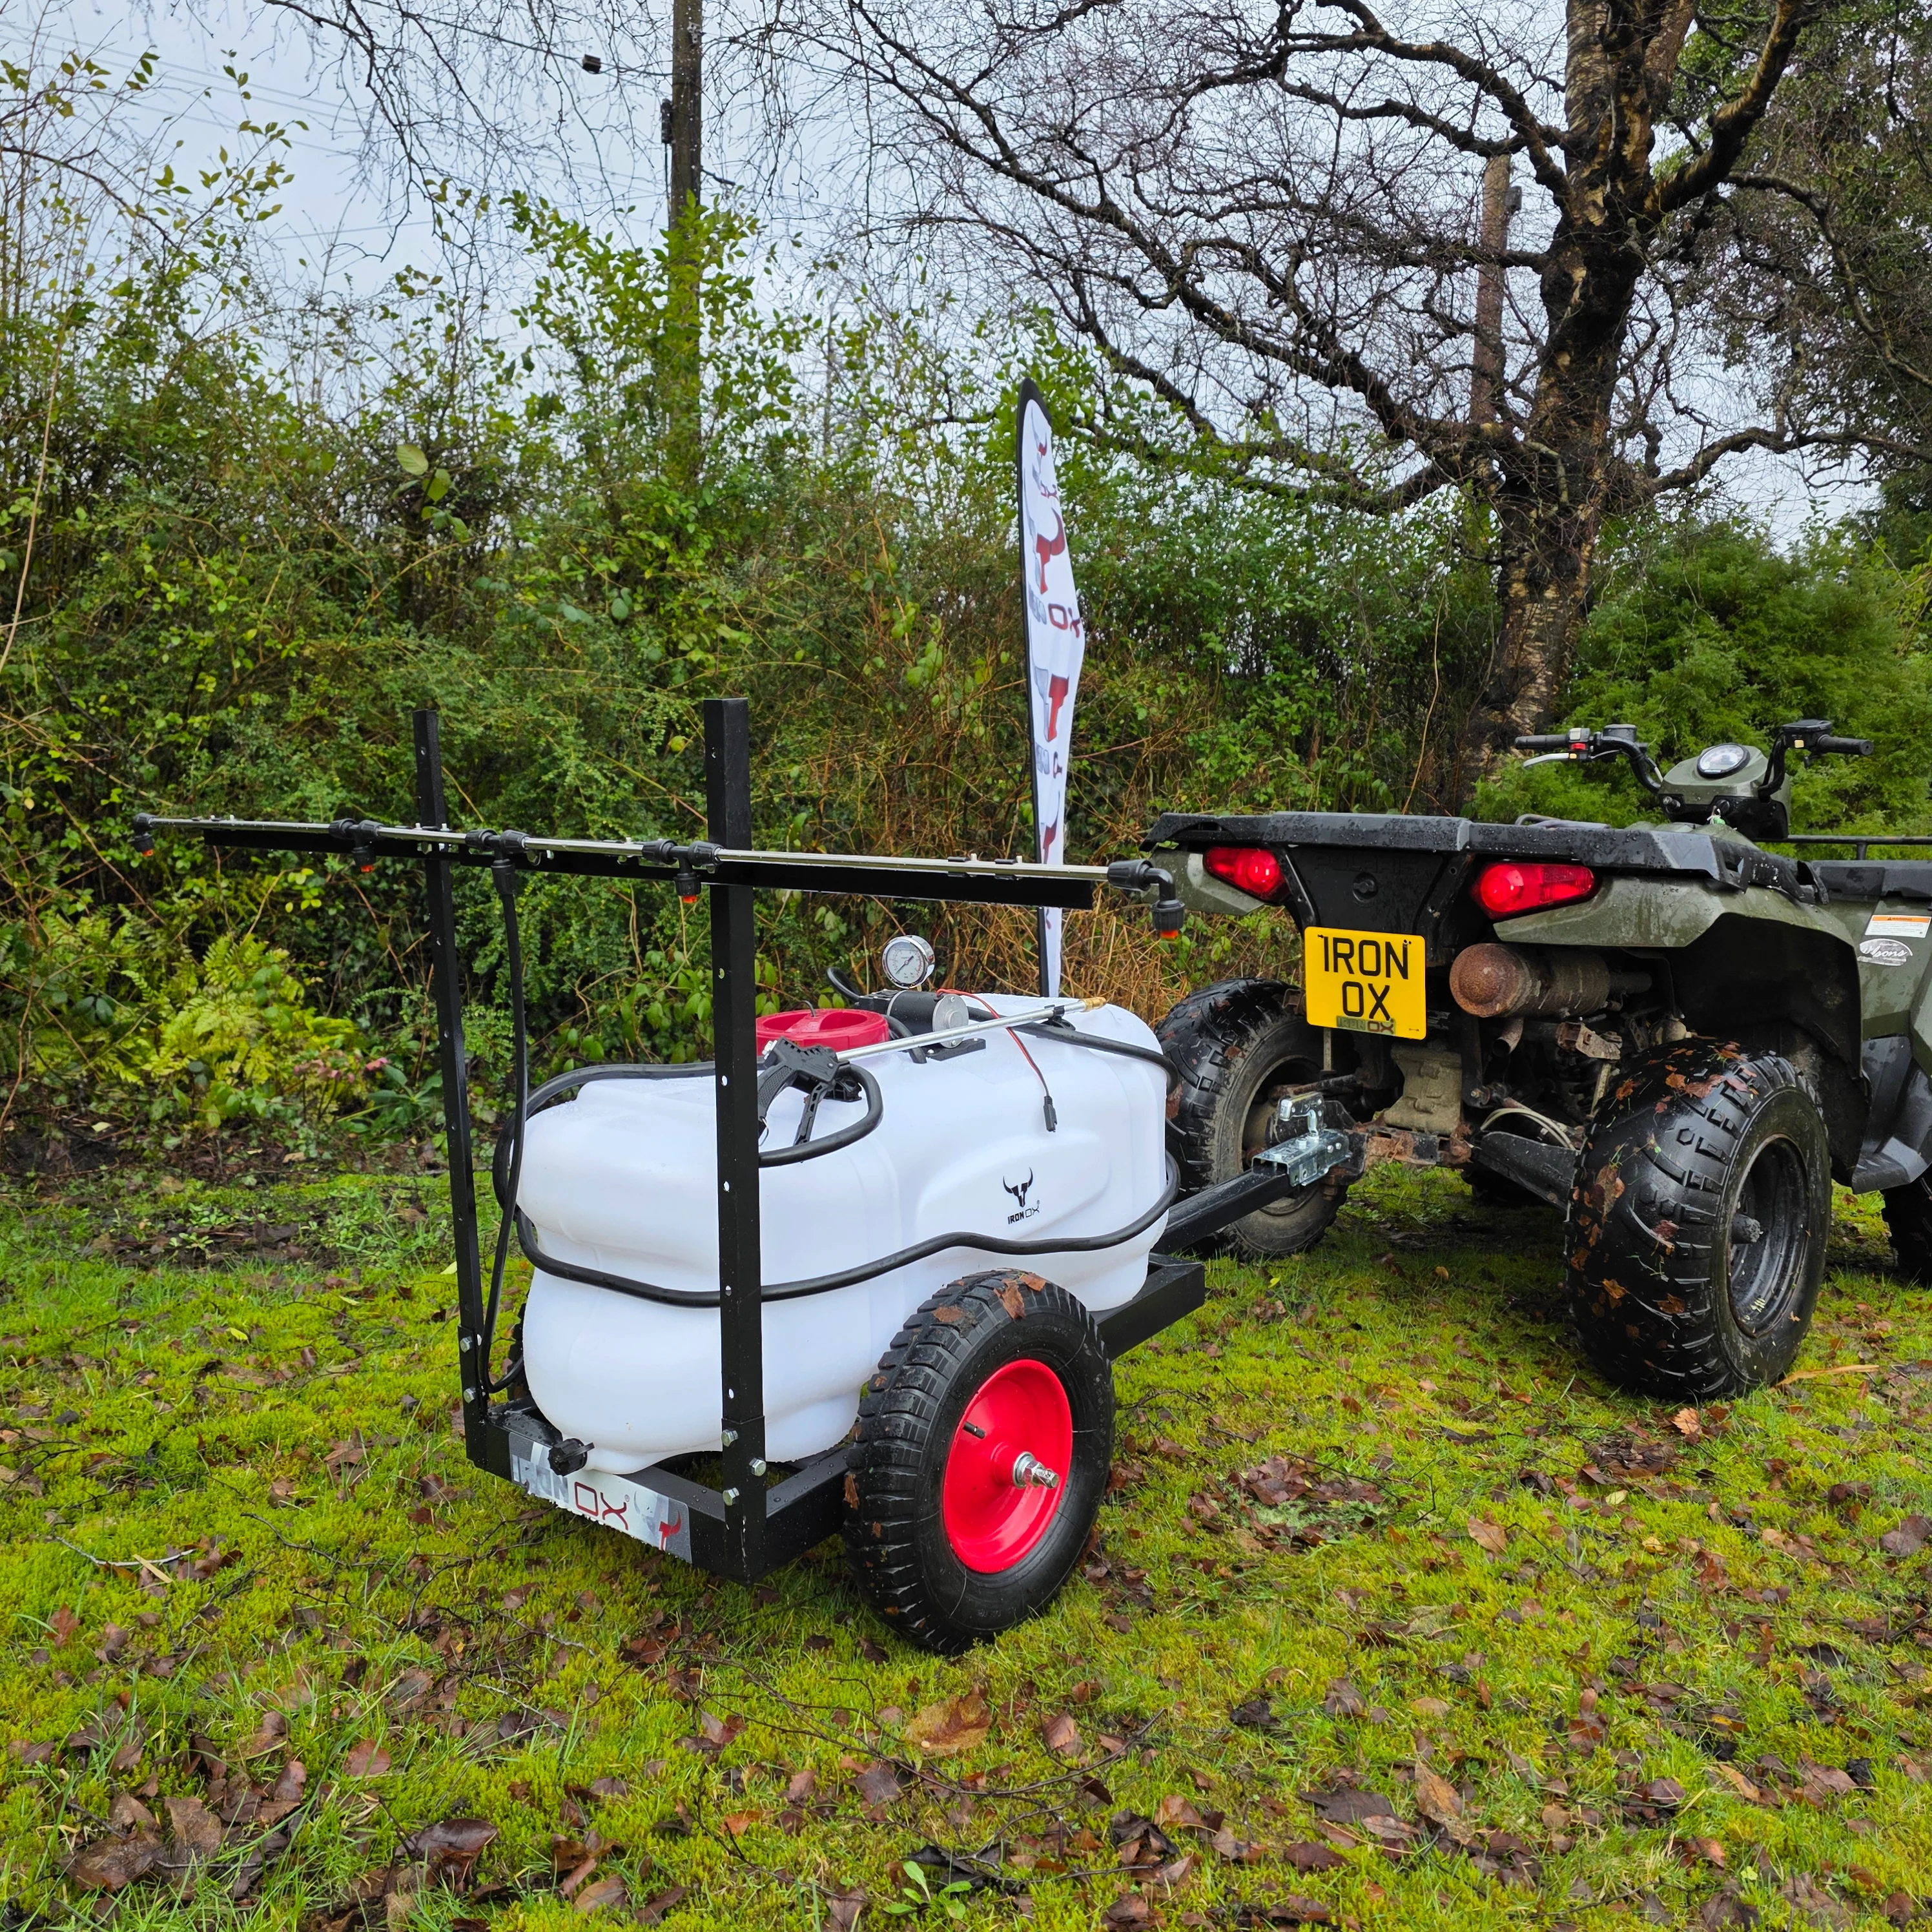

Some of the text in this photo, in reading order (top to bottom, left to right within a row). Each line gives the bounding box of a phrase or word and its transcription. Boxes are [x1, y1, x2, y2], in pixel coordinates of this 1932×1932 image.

[1048, 603, 1081, 639] OX
[1324, 936, 1408, 980] IRON
[1342, 981, 1390, 1021] OX
[1368, 1020, 1395, 1034] OX
[1008, 1204, 1040, 1224] IRON OX
[574, 1481, 630, 1531] OX
